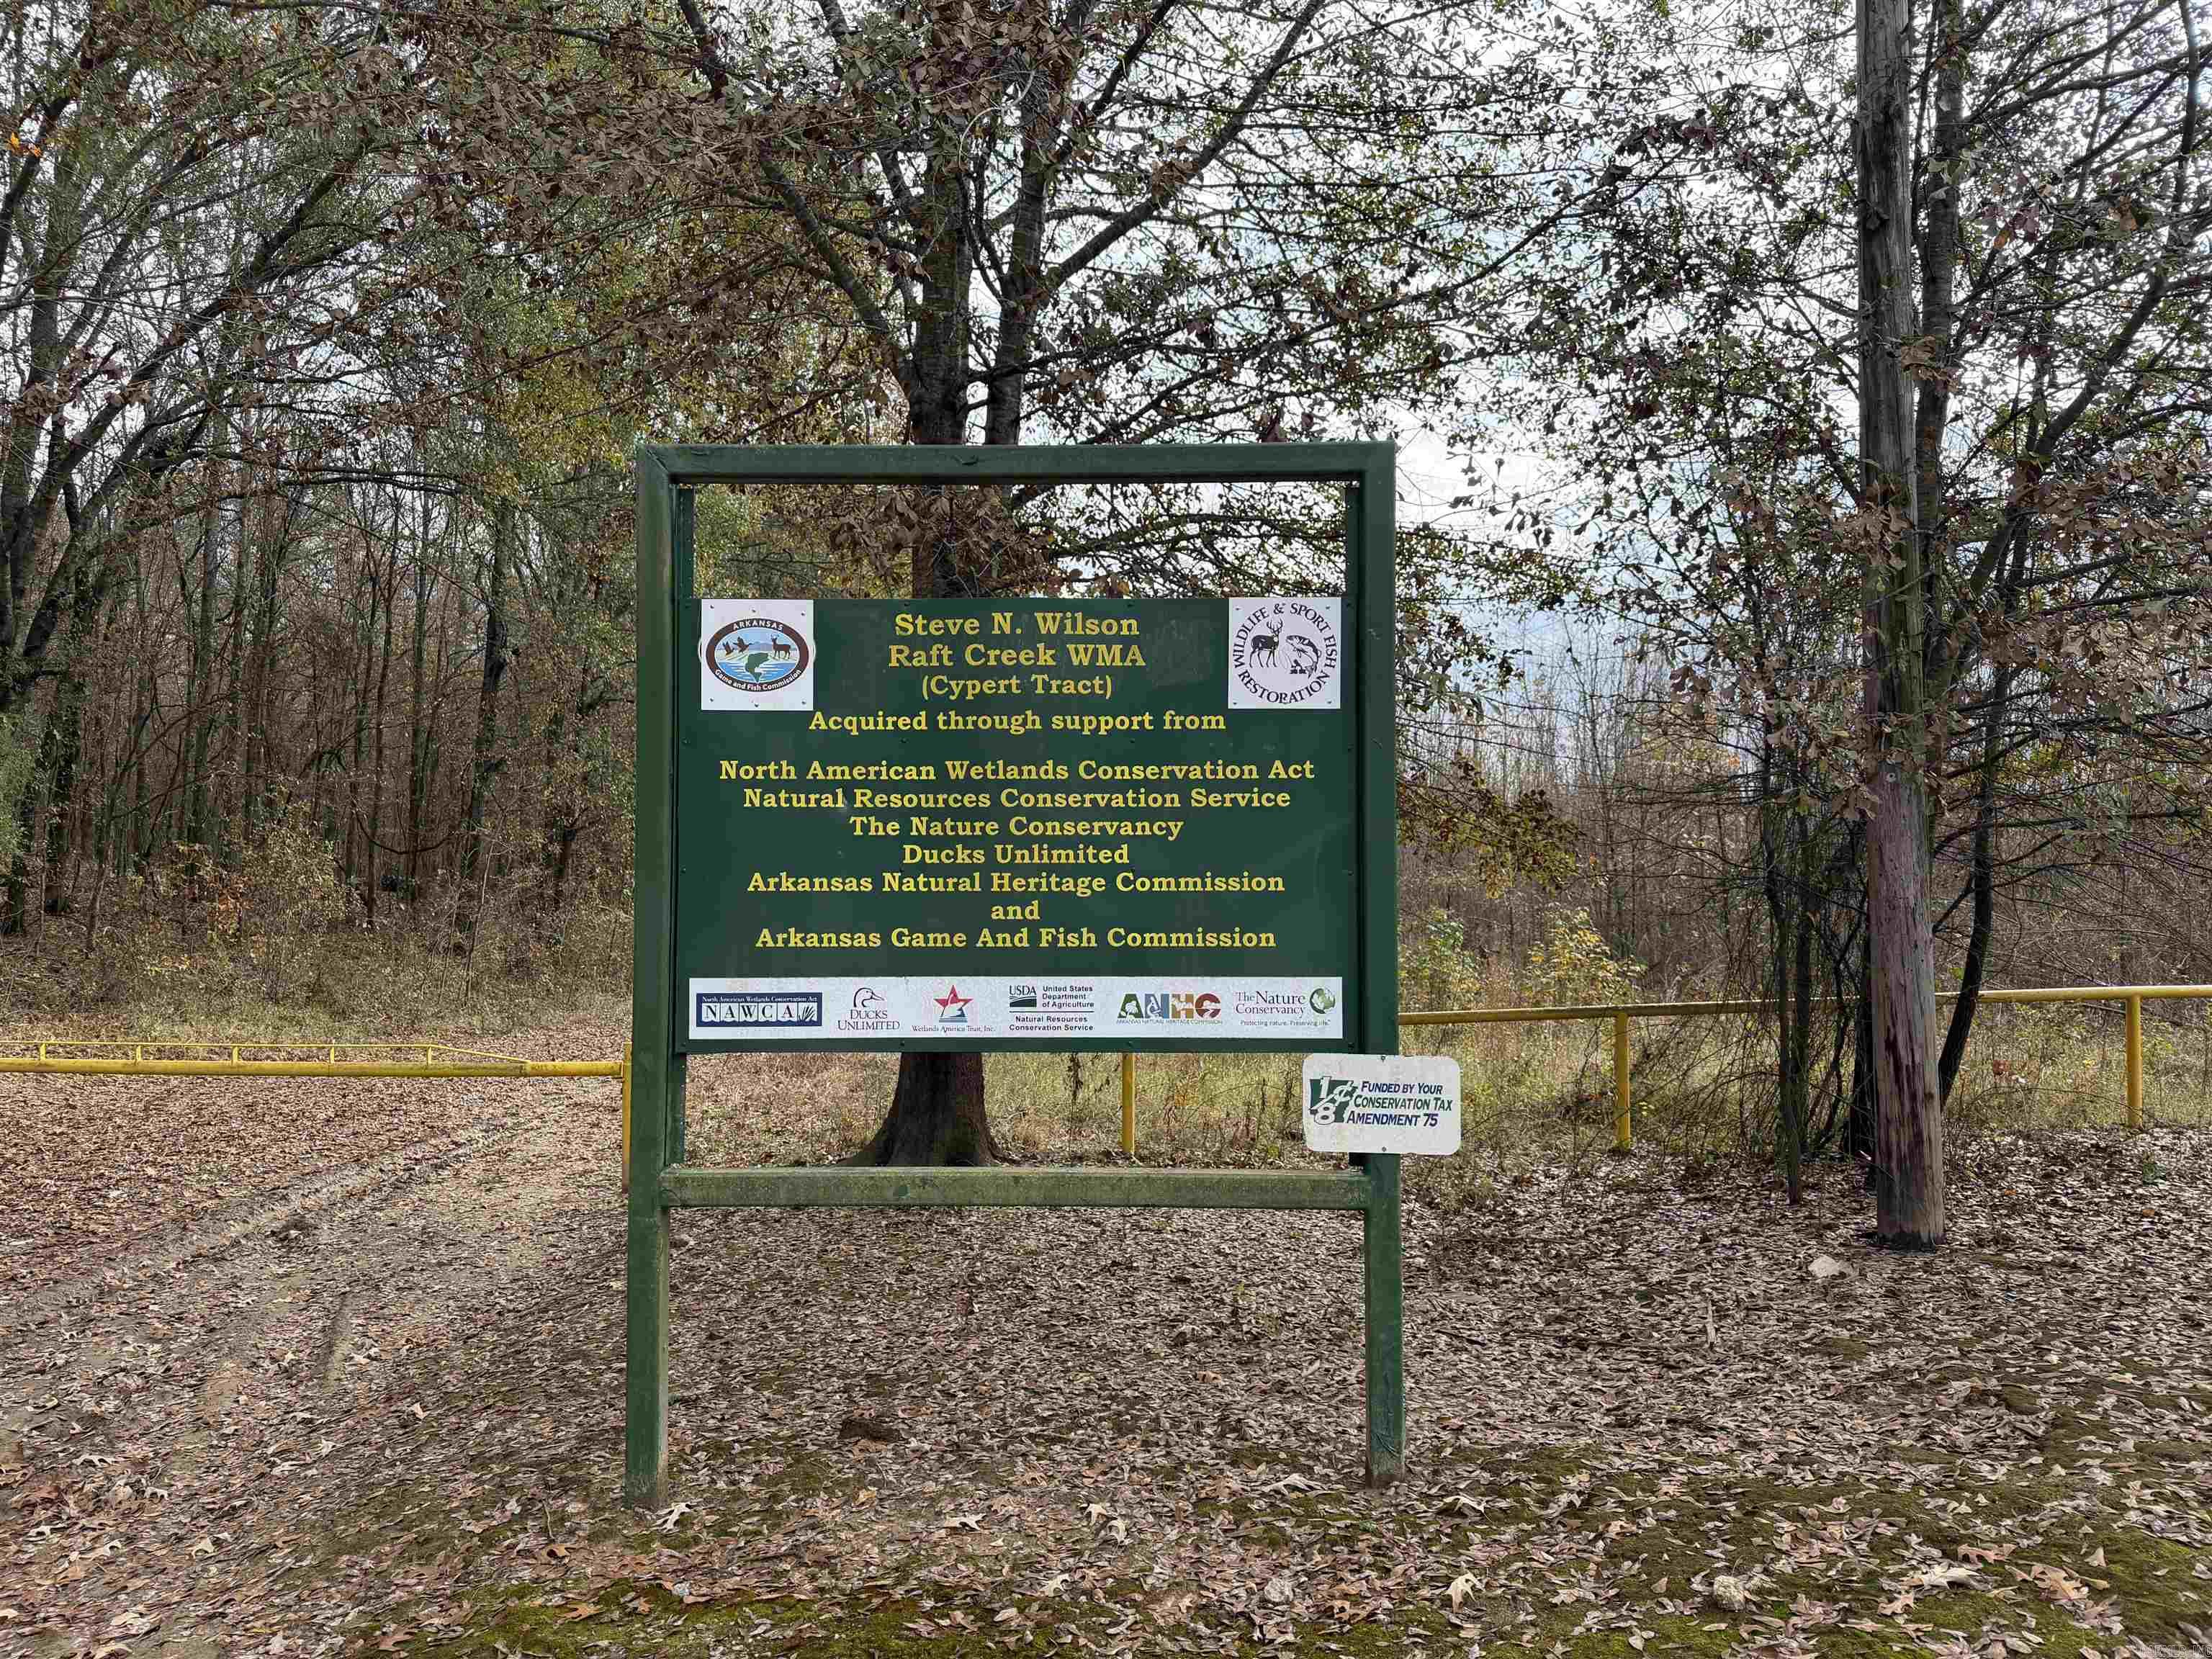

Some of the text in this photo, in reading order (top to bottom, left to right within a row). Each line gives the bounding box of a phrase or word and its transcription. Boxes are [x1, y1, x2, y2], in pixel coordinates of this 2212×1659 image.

[733, 620, 783, 631] ARKANSAS
[895, 612, 1138, 635] Steve N. Wilson
[1233, 602, 1337, 669] WILDLIFE & SPORT FISH
[889, 644, 1145, 667] Raft Creek WMA
[714, 670, 732, 685] Game
[762, 669, 801, 691] Commission
[922, 675, 1112, 700] (Cypert Tract)
[1238, 670, 1331, 703] RESTORATION
[809, 710, 1226, 736] Acquired through support from
[720, 760, 1312, 781] North American Wetlands Conservation Act
[745, 788, 1290, 808] Natural Resources Conservation Service
[851, 817, 1184, 841] The Nature Conservancy
[904, 844, 1129, 864] Ducks Unlimited
[748, 872, 1285, 896] Arkansas Natural Heritage Commission
[990, 900, 1039, 920] and
[756, 927, 1276, 948] Arkansas Game And Fish Commission
[1009, 985, 1037, 995] USDA
[1237, 991, 1305, 1004] The Nature
[705, 1004, 795, 1019] NAWCA
[850, 1009, 888, 1020] DUCKS
[1118, 993, 1222, 1019] ANHC
[1236, 1003, 1305, 1018] Conservancy
[837, 1020, 900, 1031] UNLIMITED
[1361, 1081, 1444, 1094] FUNDED BY YOUR
[1354, 1096, 1453, 1112] CONSERVATION TAX
[1346, 1110, 1439, 1127] AMENDMENT 75
